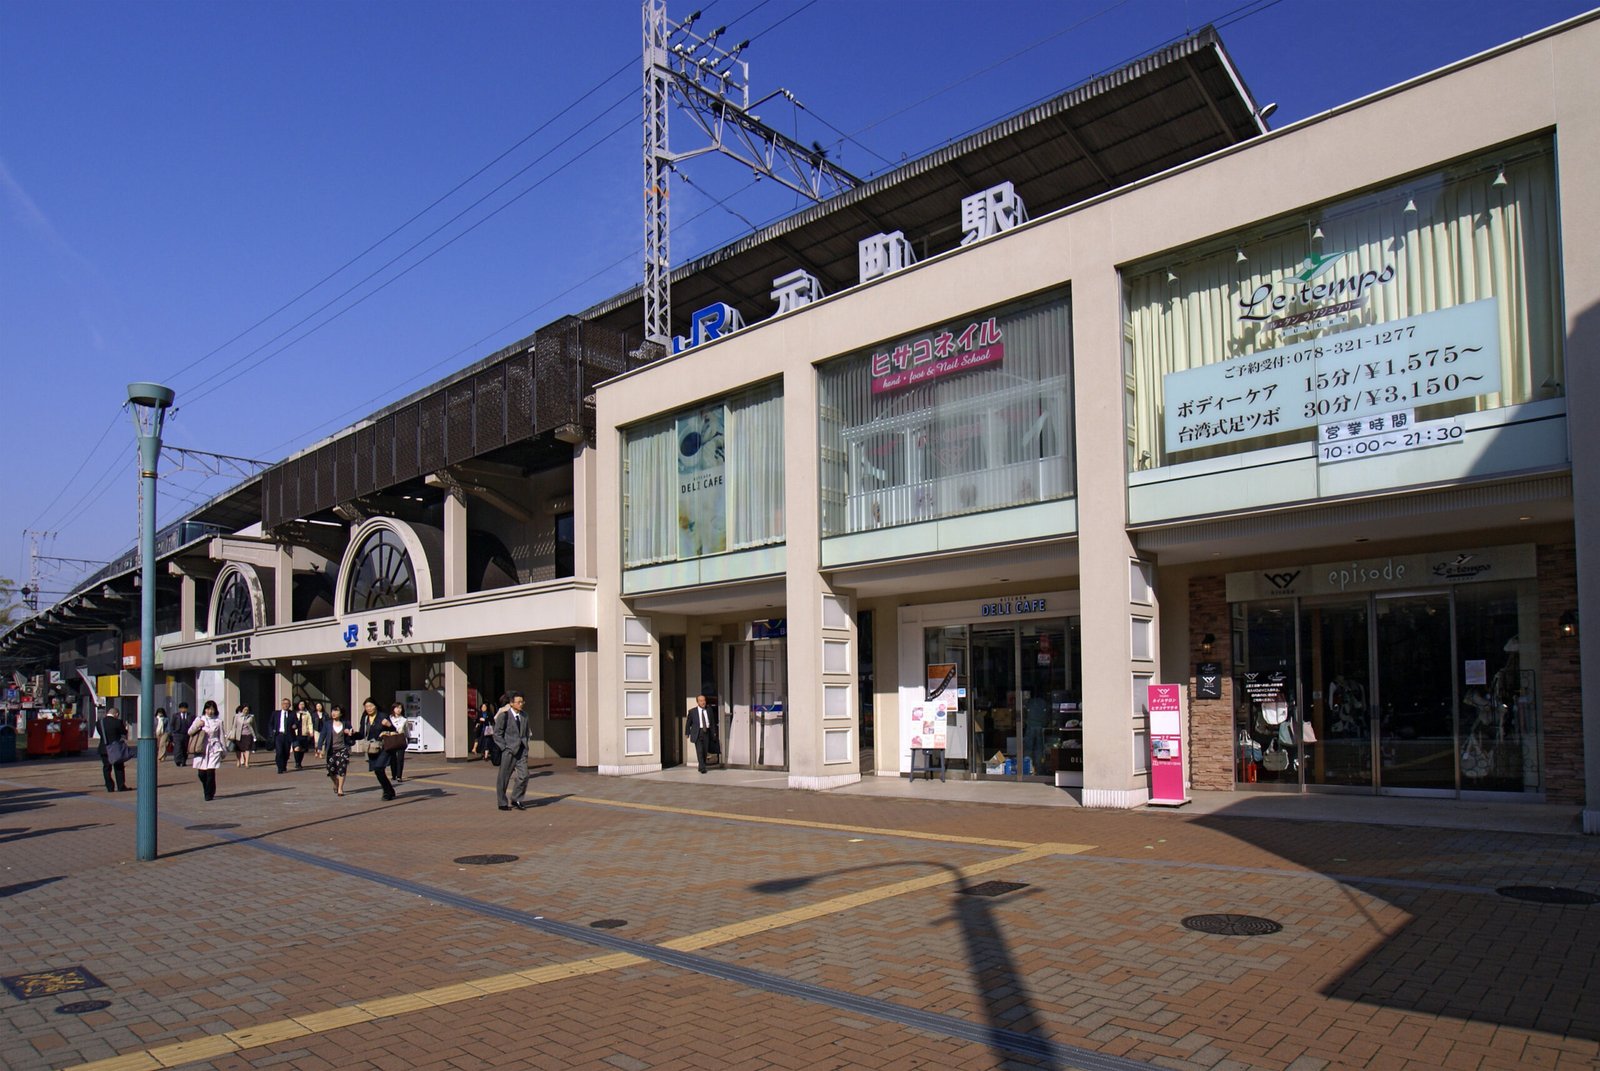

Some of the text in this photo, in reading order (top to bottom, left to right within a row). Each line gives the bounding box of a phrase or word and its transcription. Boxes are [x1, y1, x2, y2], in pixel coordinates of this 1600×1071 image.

[673, 181, 1015, 354] JR 元町駅
[871, 316, 1003, 377] ヒサコネイル
[935, 359, 959, 373] Nail
[960, 350, 992, 367] School
[1177, 383, 1279, 418] ボディーケア
[1178, 407, 1281, 444] 台湾式足ツボ
[1325, 412, 1408, 440] 営業時間
[681, 481, 700, 494] DELI
[703, 475, 723, 489] CAFE
[1328, 559, 1405, 592] episode
[981, 598, 1047, 617] DELI CAFE
[343, 623, 359, 643] JR
